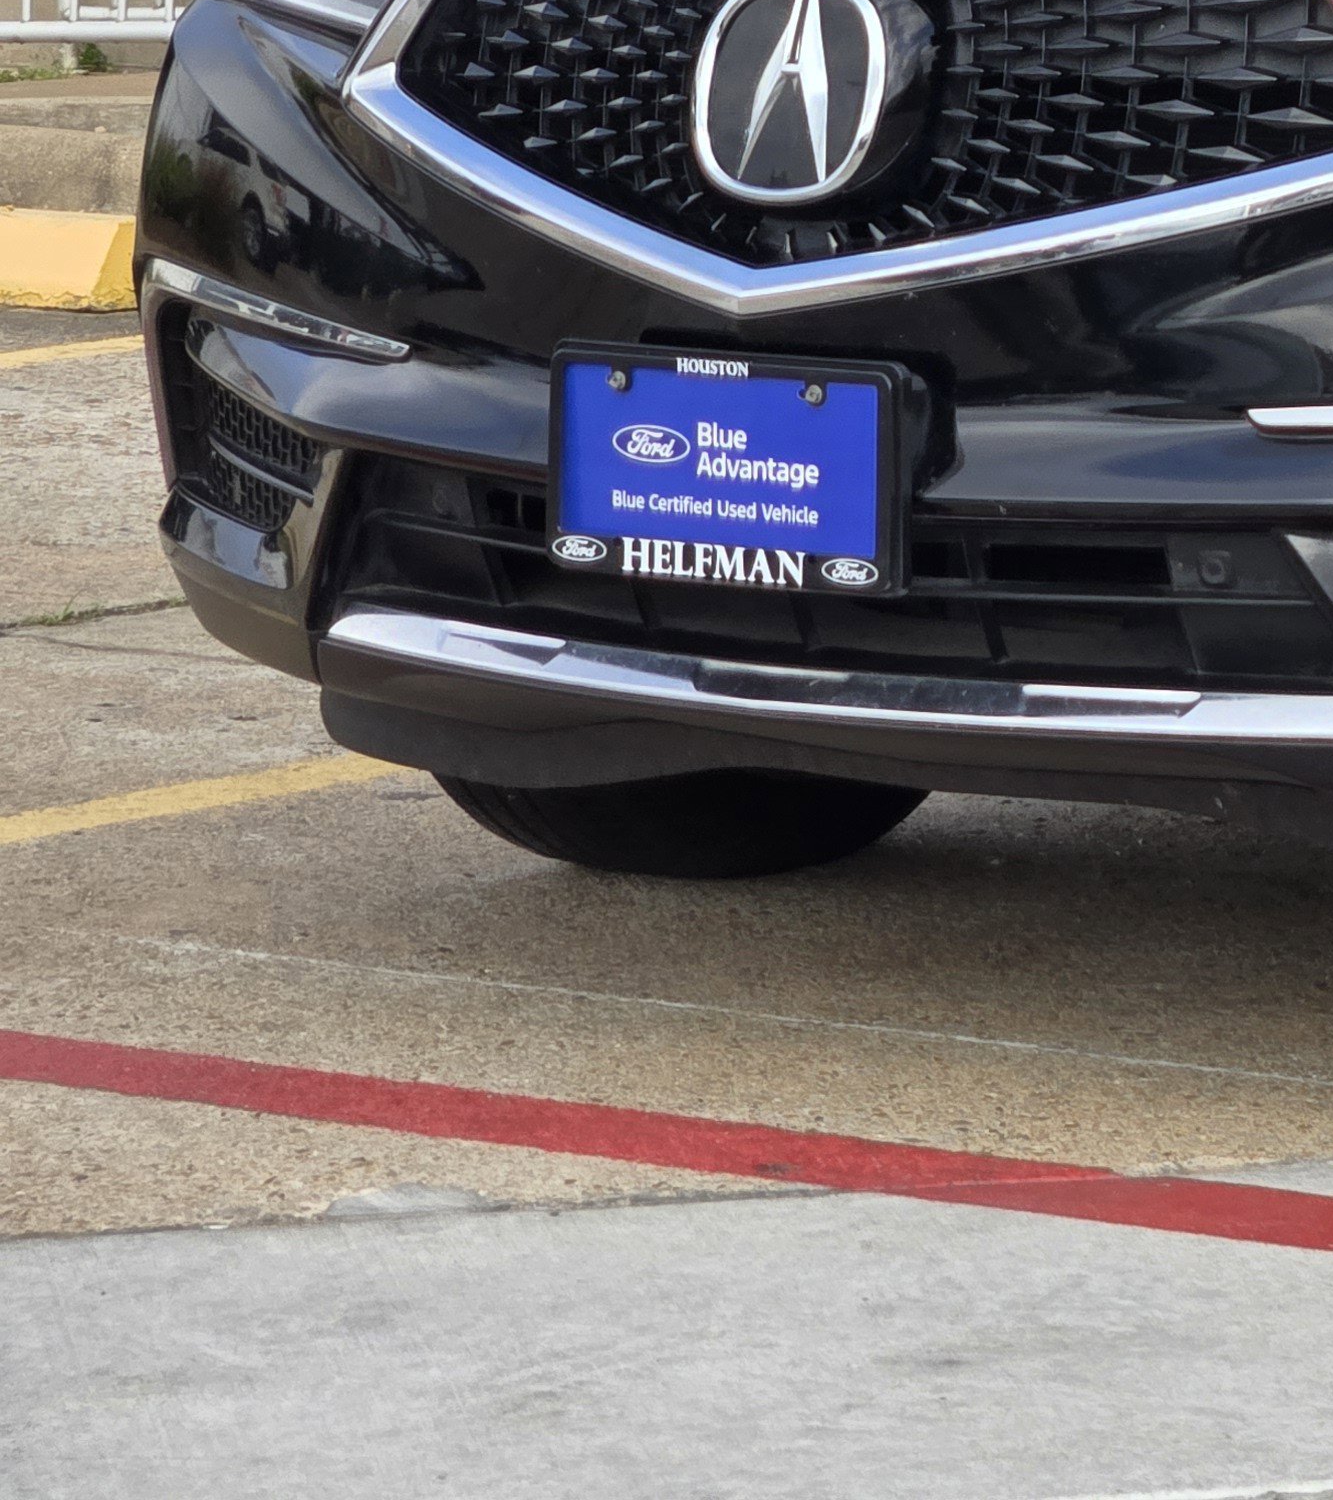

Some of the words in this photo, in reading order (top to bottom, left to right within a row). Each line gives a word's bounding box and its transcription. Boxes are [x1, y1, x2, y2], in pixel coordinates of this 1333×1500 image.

[676, 357, 749, 377] HOUSTON
[627, 428, 676, 458] Ford
[697, 421, 747, 450] Blue
[697, 452, 819, 488] Advantage
[612, 489, 645, 510] Blue
[649, 493, 712, 516] Certified
[717, 500, 757, 520] Used
[761, 503, 819, 525] Vehicle
[562, 539, 597, 559] Ford
[621, 536, 806, 587] HELFMAN
[832, 562, 868, 581] Ford
